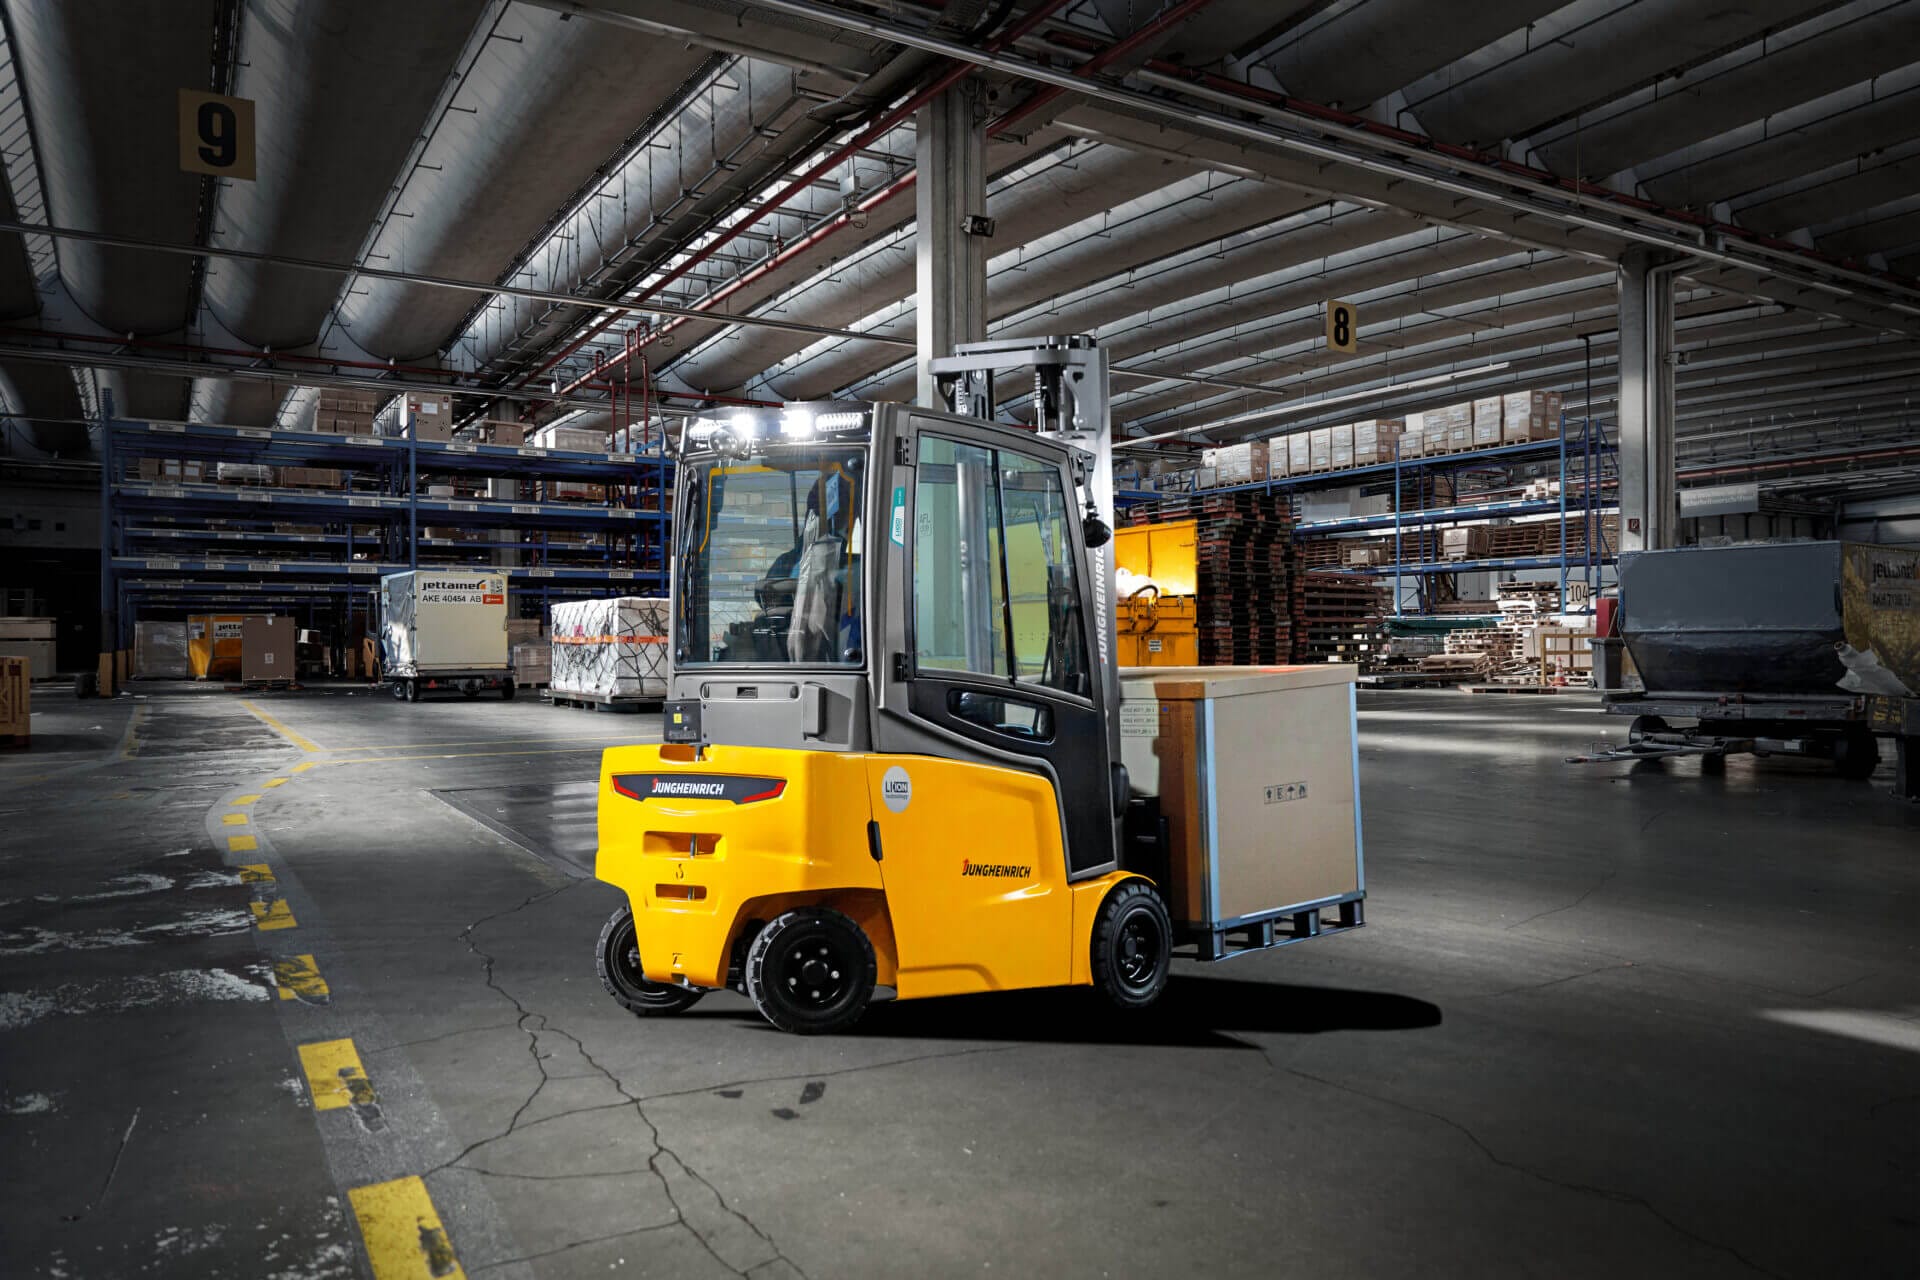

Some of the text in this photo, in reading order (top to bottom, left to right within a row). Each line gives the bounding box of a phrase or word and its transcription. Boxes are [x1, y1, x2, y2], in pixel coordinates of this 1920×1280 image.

[197, 102, 236, 167] 9
[1334, 306, 1349, 347] 8
[422, 580, 486, 590] jettainer
[1570, 584, 1588, 602] 104
[1095, 546, 1107, 664] JUNGHEINRIC
[652, 778, 724, 795] JUNGHEINRICH
[962, 858, 1032, 878] JUNGHEINRICH
